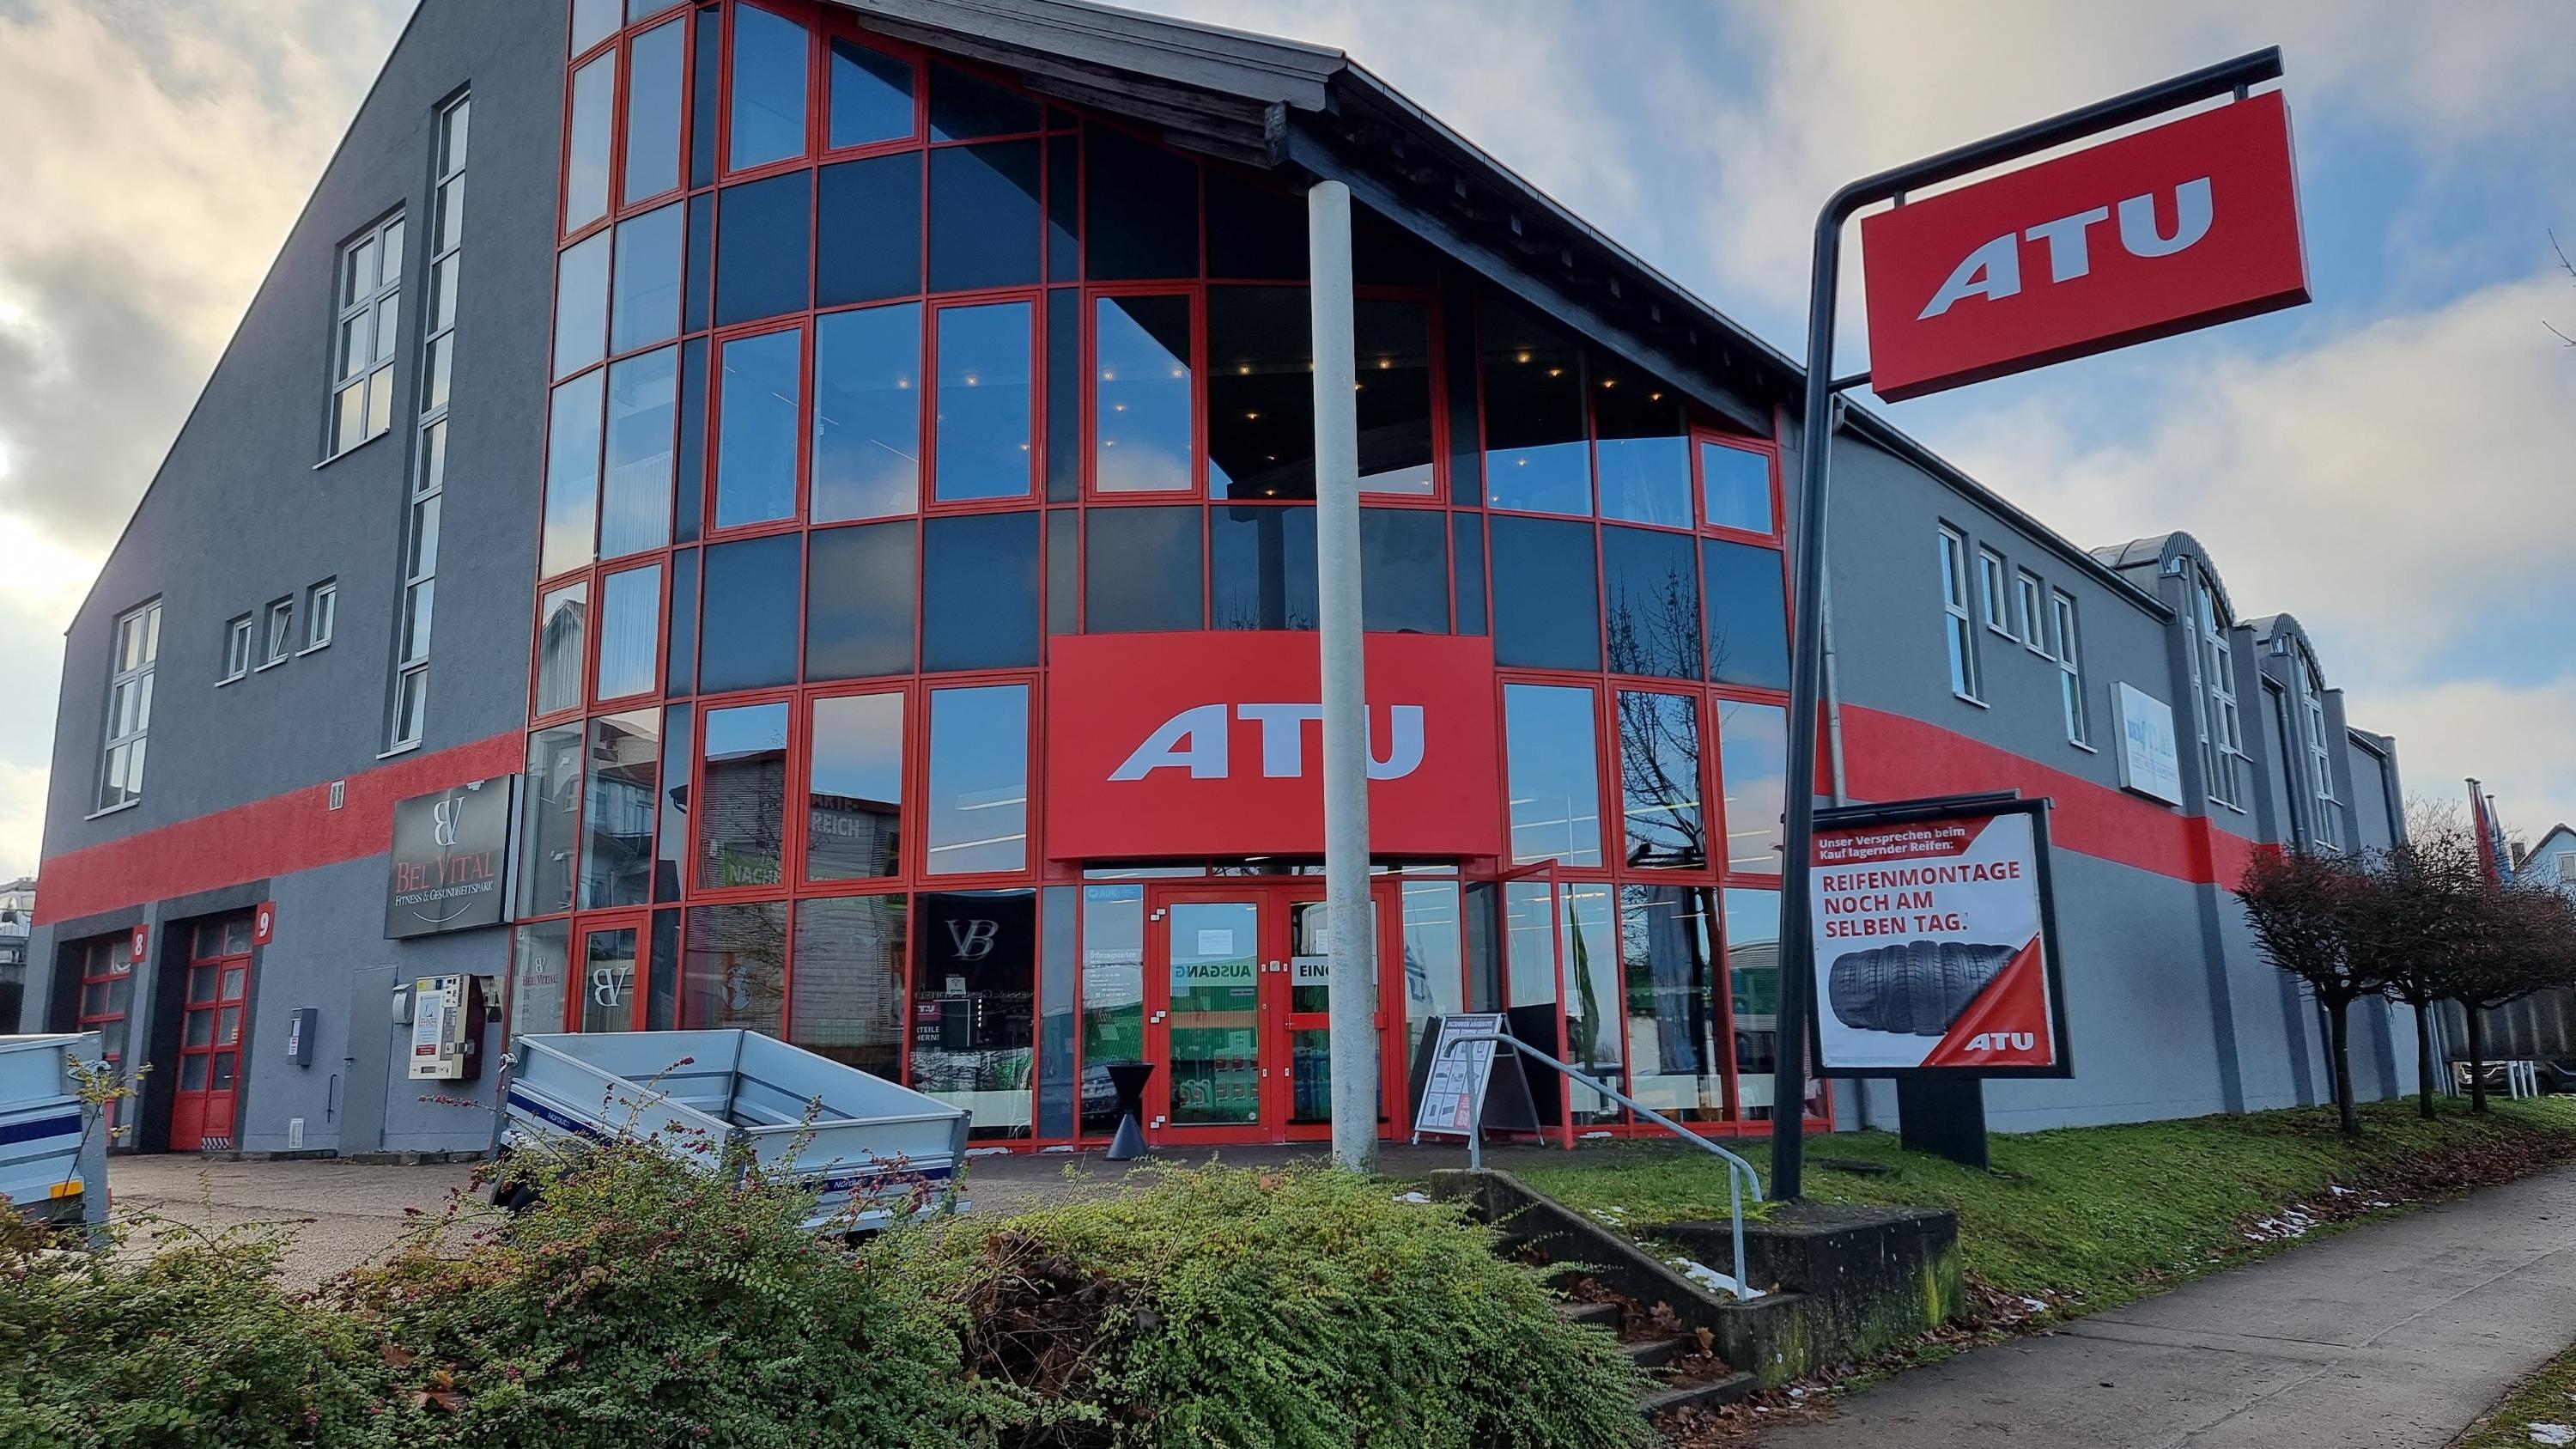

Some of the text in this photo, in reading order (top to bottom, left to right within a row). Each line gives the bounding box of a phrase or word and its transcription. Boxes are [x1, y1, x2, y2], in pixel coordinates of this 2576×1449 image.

[1916, 176, 2215, 321] ATU
[1107, 703, 1425, 781] ATU
[1820, 826, 1965, 849] Unser Versprechen beim
[1820, 840, 1953, 860] Kauf lagernder Reifen:
[1823, 861, 2020, 892] REIFENMONTAGE
[1824, 891, 1934, 914] NOCH AM
[259, 911, 269, 938] 9
[1826, 916, 1906, 937] SELBEN
[135, 934, 143, 956] 8
[1964, 1032, 2034, 1051] ATU
